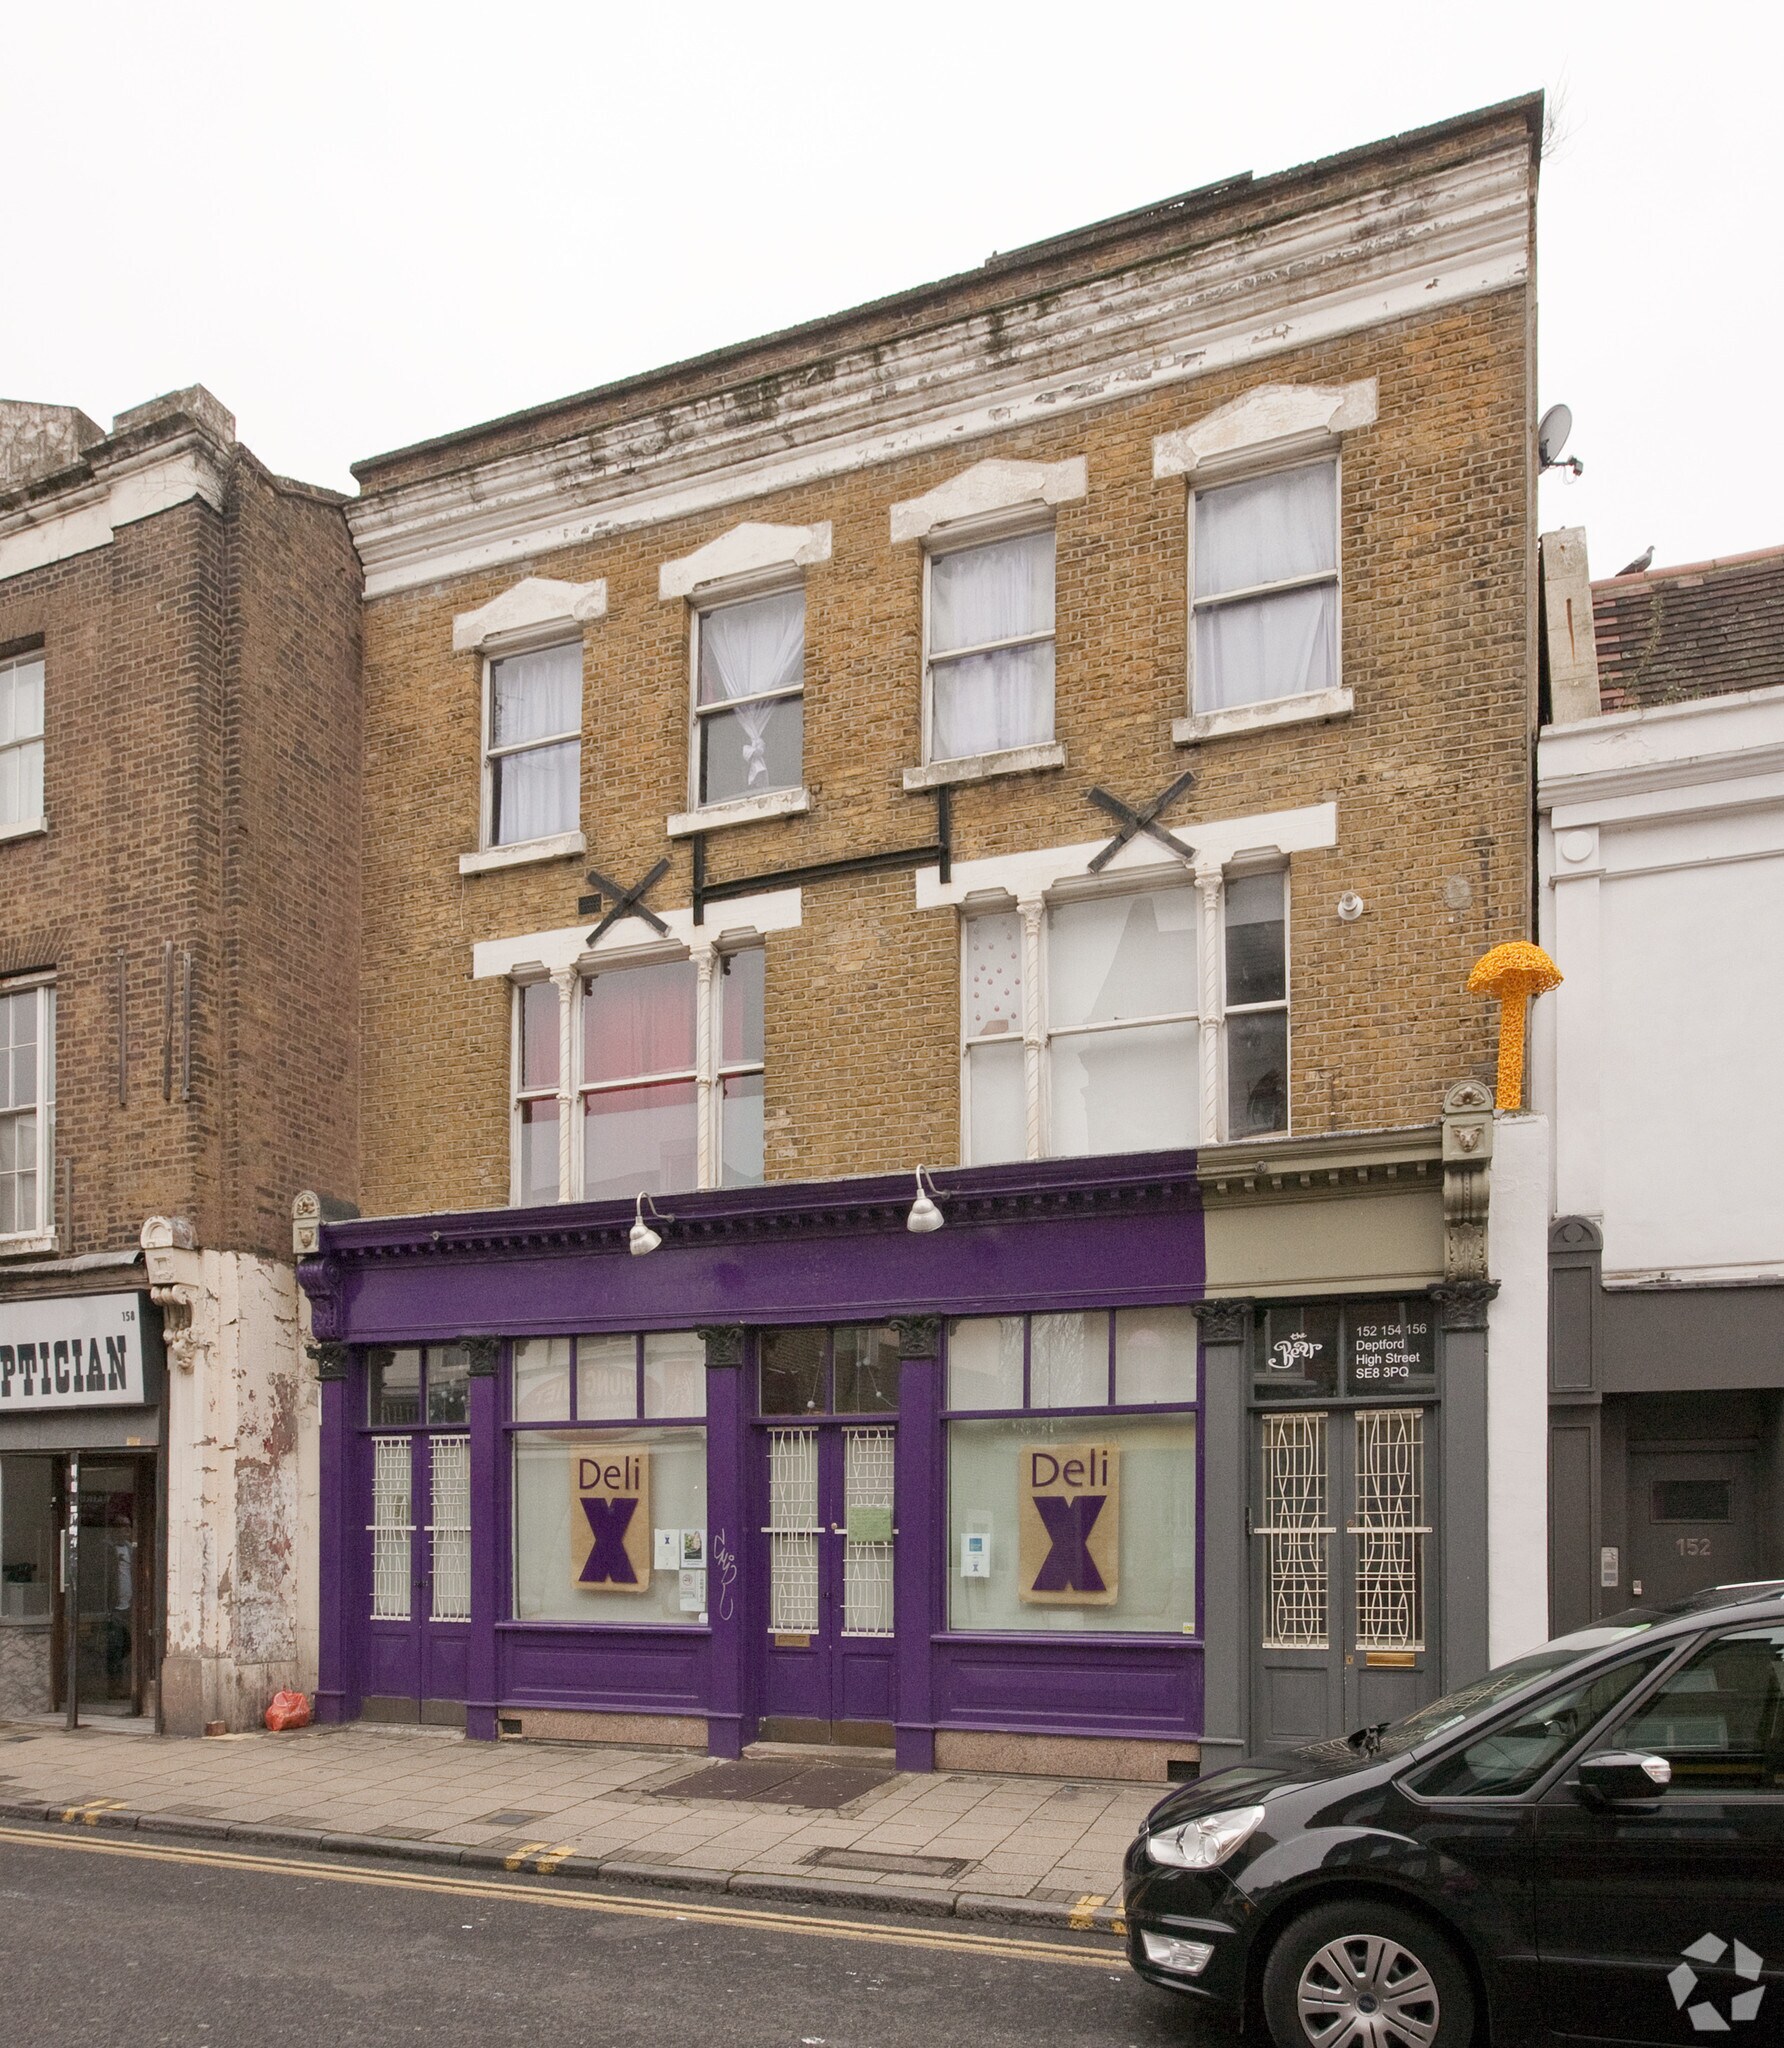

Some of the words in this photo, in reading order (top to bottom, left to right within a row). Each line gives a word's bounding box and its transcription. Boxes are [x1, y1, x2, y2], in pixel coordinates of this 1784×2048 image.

[121, 1310, 135, 1321] 158
[1290, 1332, 1307, 1340] the
[1356, 1325, 1377, 1337] 152
[1381, 1324, 1402, 1336] 154
[1406, 1323, 1427, 1335] 156
[1268, 1340, 1323, 1369] Bear
[1356, 1338, 1405, 1353] Deptford
[0, 1335, 127, 1397] PTICIAN
[1356, 1353, 1382, 1367] High
[1385, 1352, 1420, 1364] Street
[1355, 1367, 1380, 1379] SE8
[1383, 1366, 1409, 1378] 3PQ
[579, 1456, 640, 1490] Deli
[1032, 1448, 1108, 1488] Deli
[578, 1497, 639, 1584] X
[1031, 1495, 1107, 1592] X
[1675, 1538, 1711, 1556] 152
